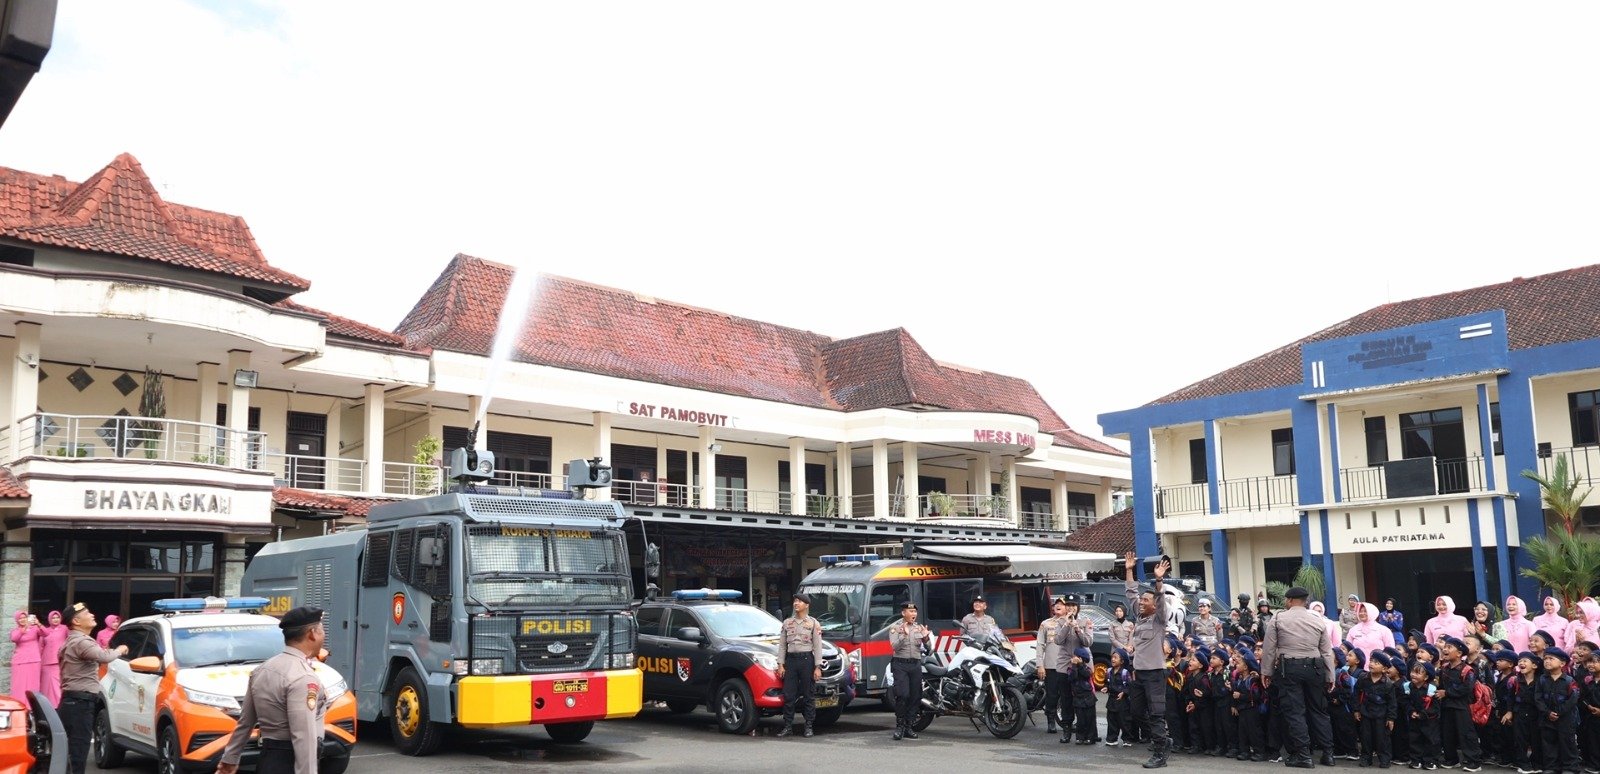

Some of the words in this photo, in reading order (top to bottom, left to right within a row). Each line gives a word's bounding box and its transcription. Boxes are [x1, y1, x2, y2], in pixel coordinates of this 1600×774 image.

[629, 402, 656, 417] SAT
[660, 406, 728, 427] PAMOBVIT
[973, 429, 1012, 444] MESS
[84, 489, 232, 515] BHAYANGKARI
[1352, 537, 1379, 545] AULA
[1382, 533, 1446, 543] PATRIATAMA
[909, 567, 962, 577] POLRESTA
[522, 620, 592, 635] POLISI
[637, 656, 674, 674] OLISI
